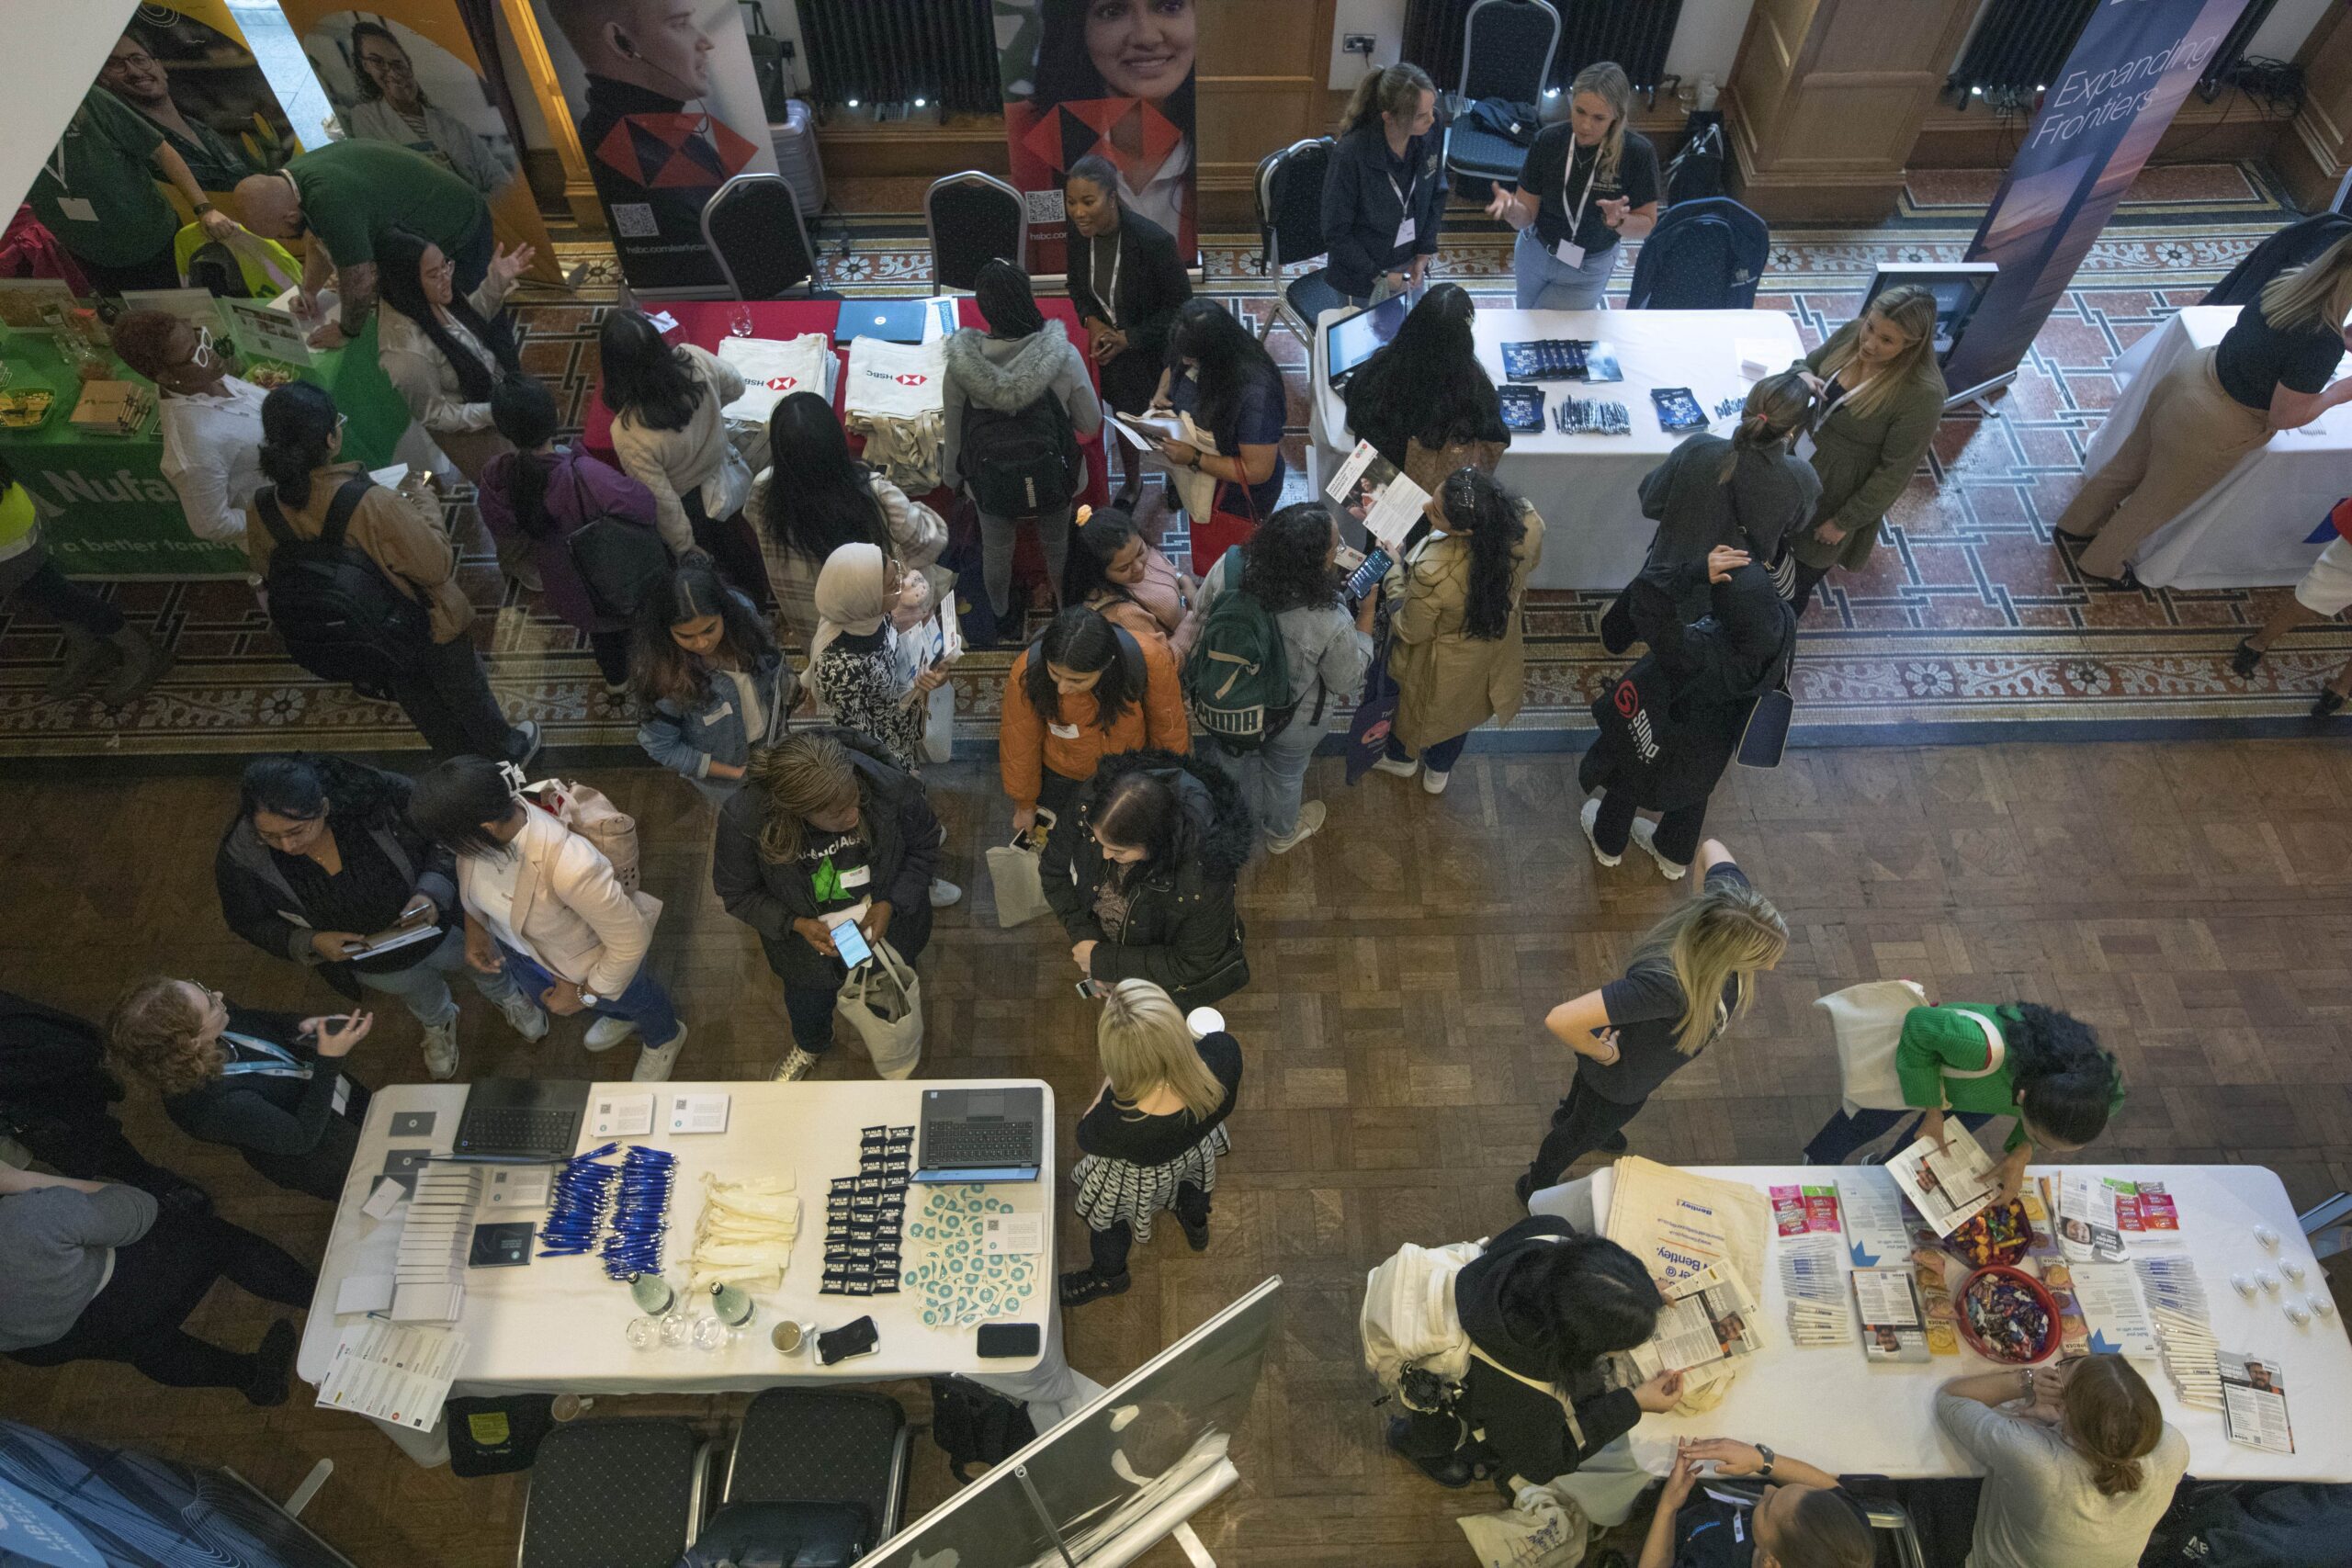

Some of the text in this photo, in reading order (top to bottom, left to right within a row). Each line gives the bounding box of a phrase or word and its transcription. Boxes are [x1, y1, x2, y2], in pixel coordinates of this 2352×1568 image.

[2053, 34, 2221, 108] Expanding
[2031, 87, 2160, 149] Frontiers
[625, 243, 707, 254] hsbc.com/earlycar
[941, 302, 952, 333] Upcomin
[744, 378, 764, 387] HSB
[865, 370, 893, 380] HSBC
[40, 469, 179, 503] Nufa
[81, 538, 158, 552] better
[163, 538, 239, 550] tomor
[1627, 723, 1650, 764] DIGITAL
[1633, 708, 1660, 759] SUMO
[1680, 1201, 1713, 1215] Bentley
[1657, 1247, 1701, 1272] Bentley.
[1666, 1266, 1677, 1278] @
[0, 1501, 63, 1551] LIBER
